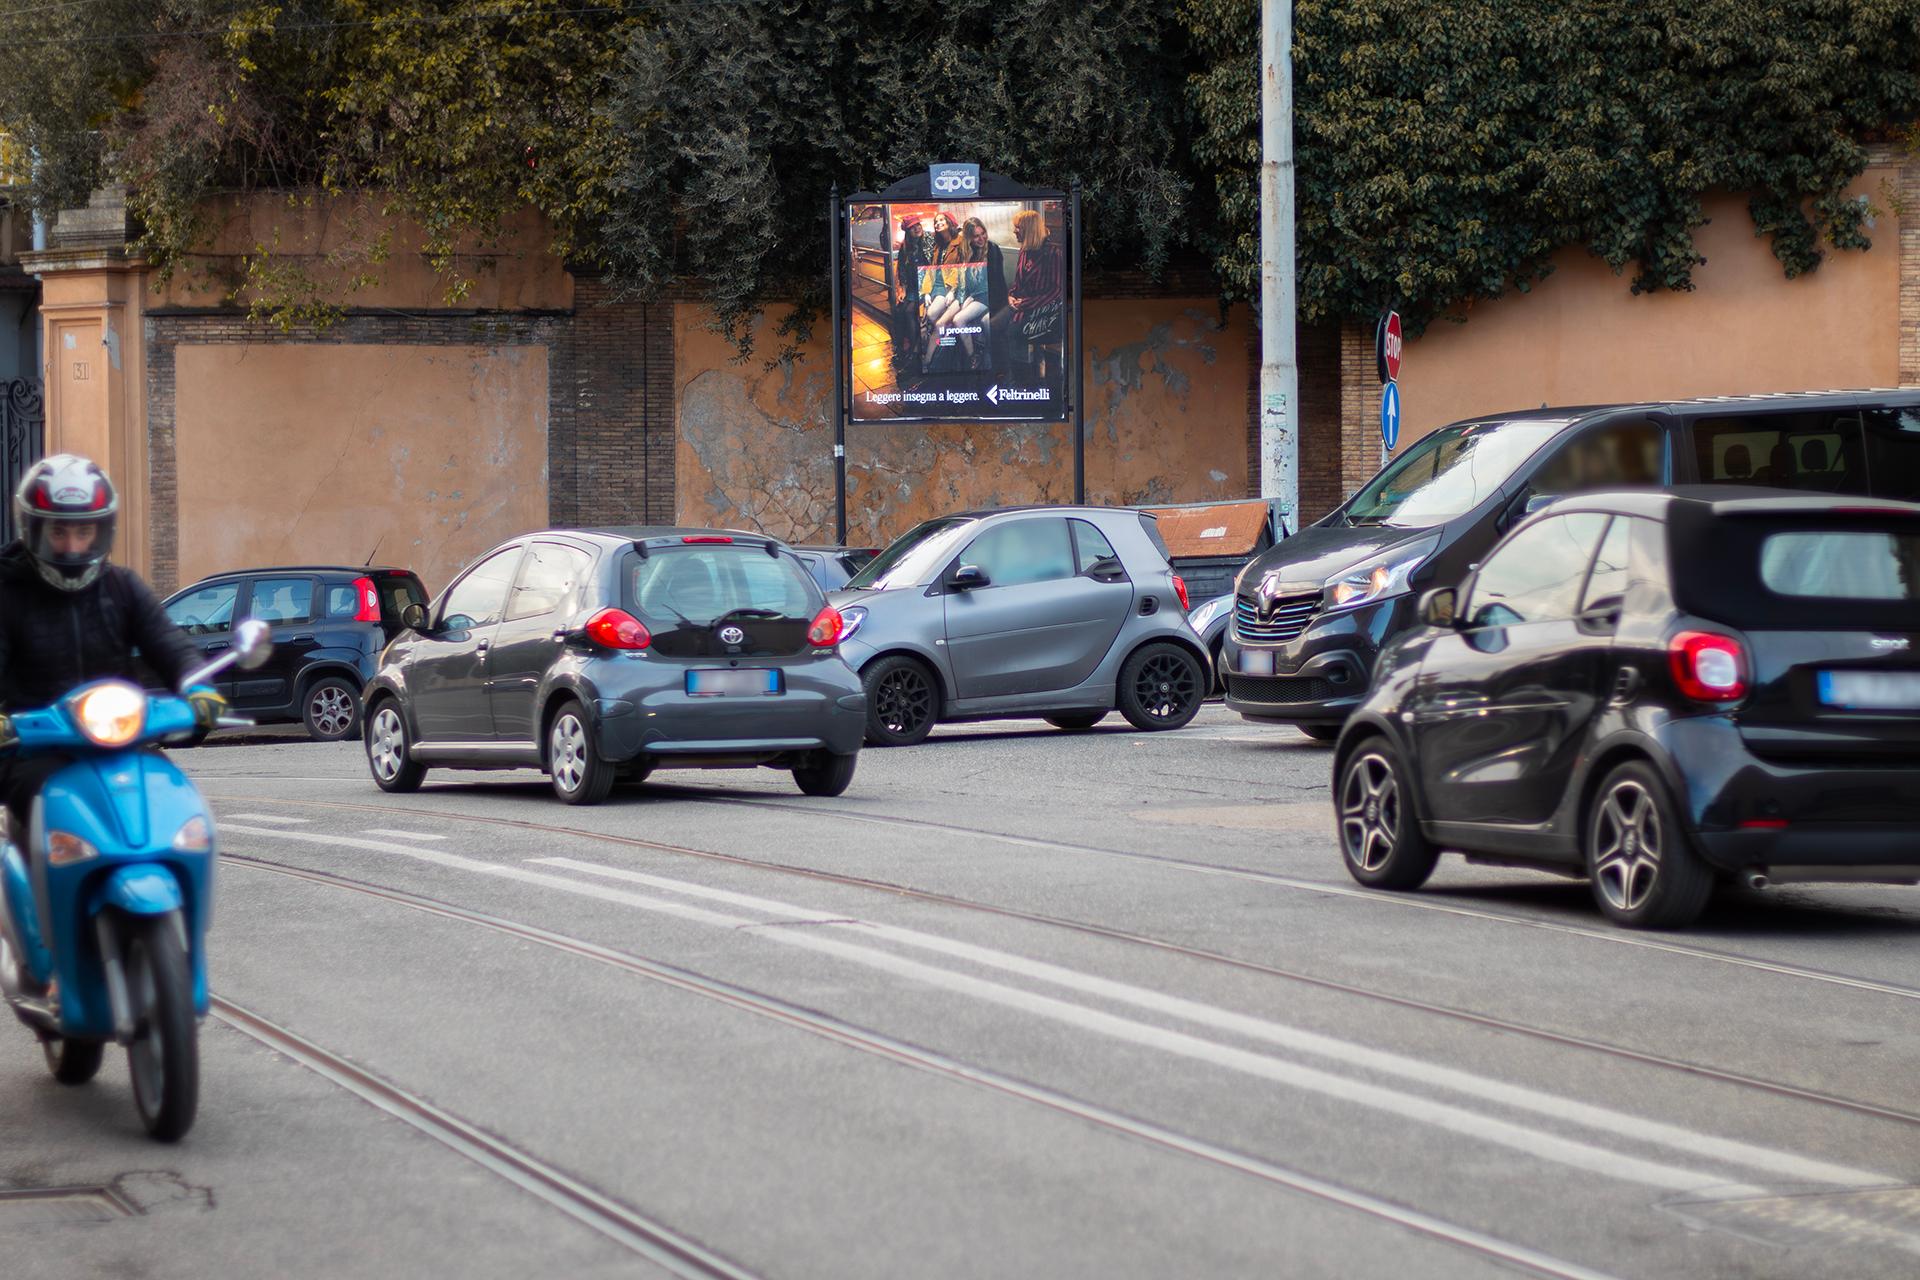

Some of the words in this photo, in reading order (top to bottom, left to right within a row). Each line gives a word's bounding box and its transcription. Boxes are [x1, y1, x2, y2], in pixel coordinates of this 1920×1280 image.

[934, 176, 976, 192] apa
[946, 326, 982, 336] processo
[1386, 331, 1401, 361] STOP
[866, 391, 901, 404] Leggere
[903, 390, 937, 404] insegna
[938, 393, 945, 402] a
[946, 389, 980, 404] leggere.
[998, 388, 1050, 401] Feltrinelli
